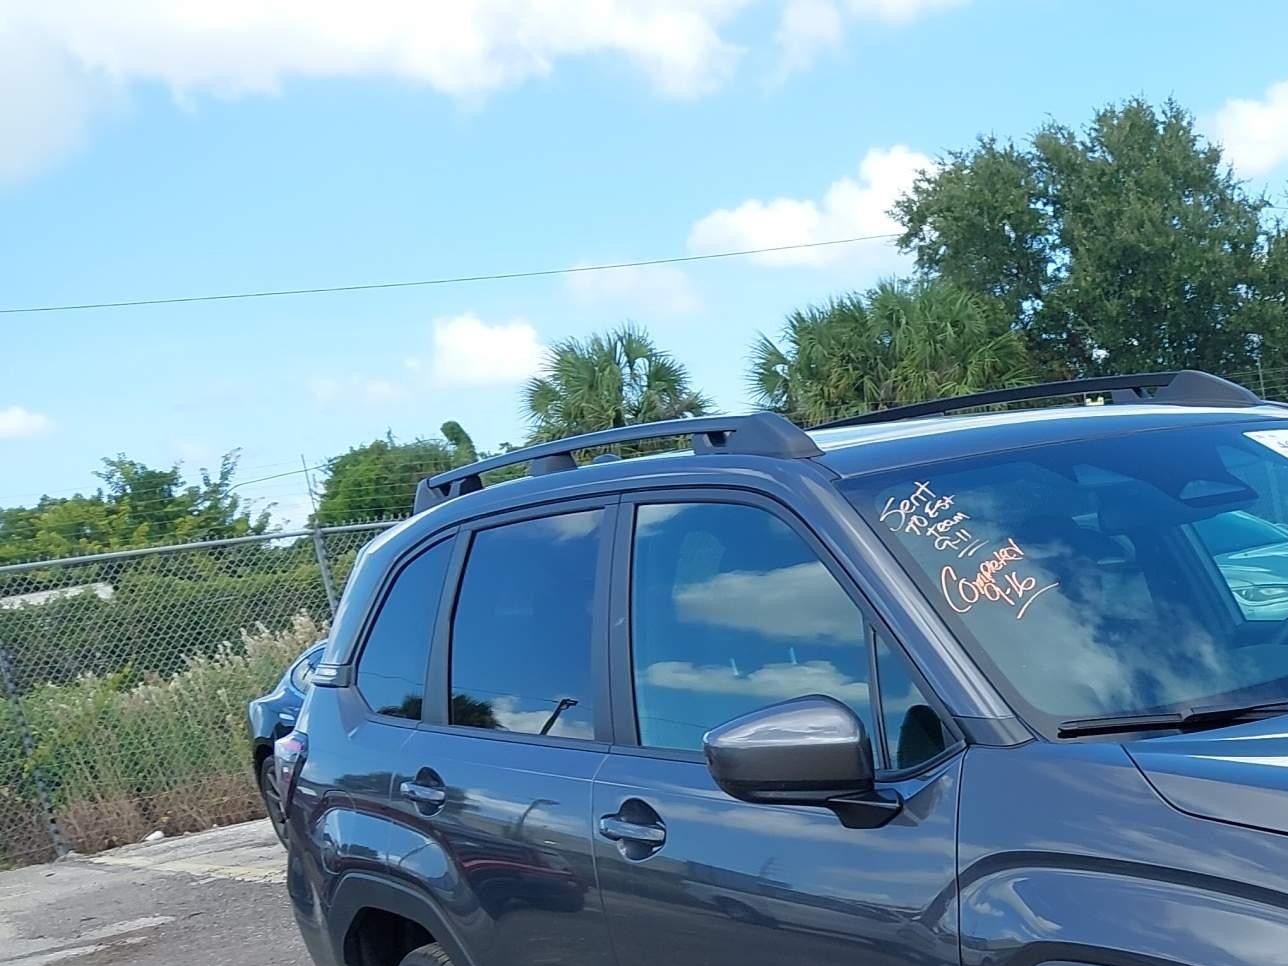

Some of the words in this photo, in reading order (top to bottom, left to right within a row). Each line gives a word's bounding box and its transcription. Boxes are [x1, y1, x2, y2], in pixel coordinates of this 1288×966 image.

[879, 480, 937, 532] Sent
[934, 528, 972, 551] 9-11
[984, 571, 1036, 606] 9-16
